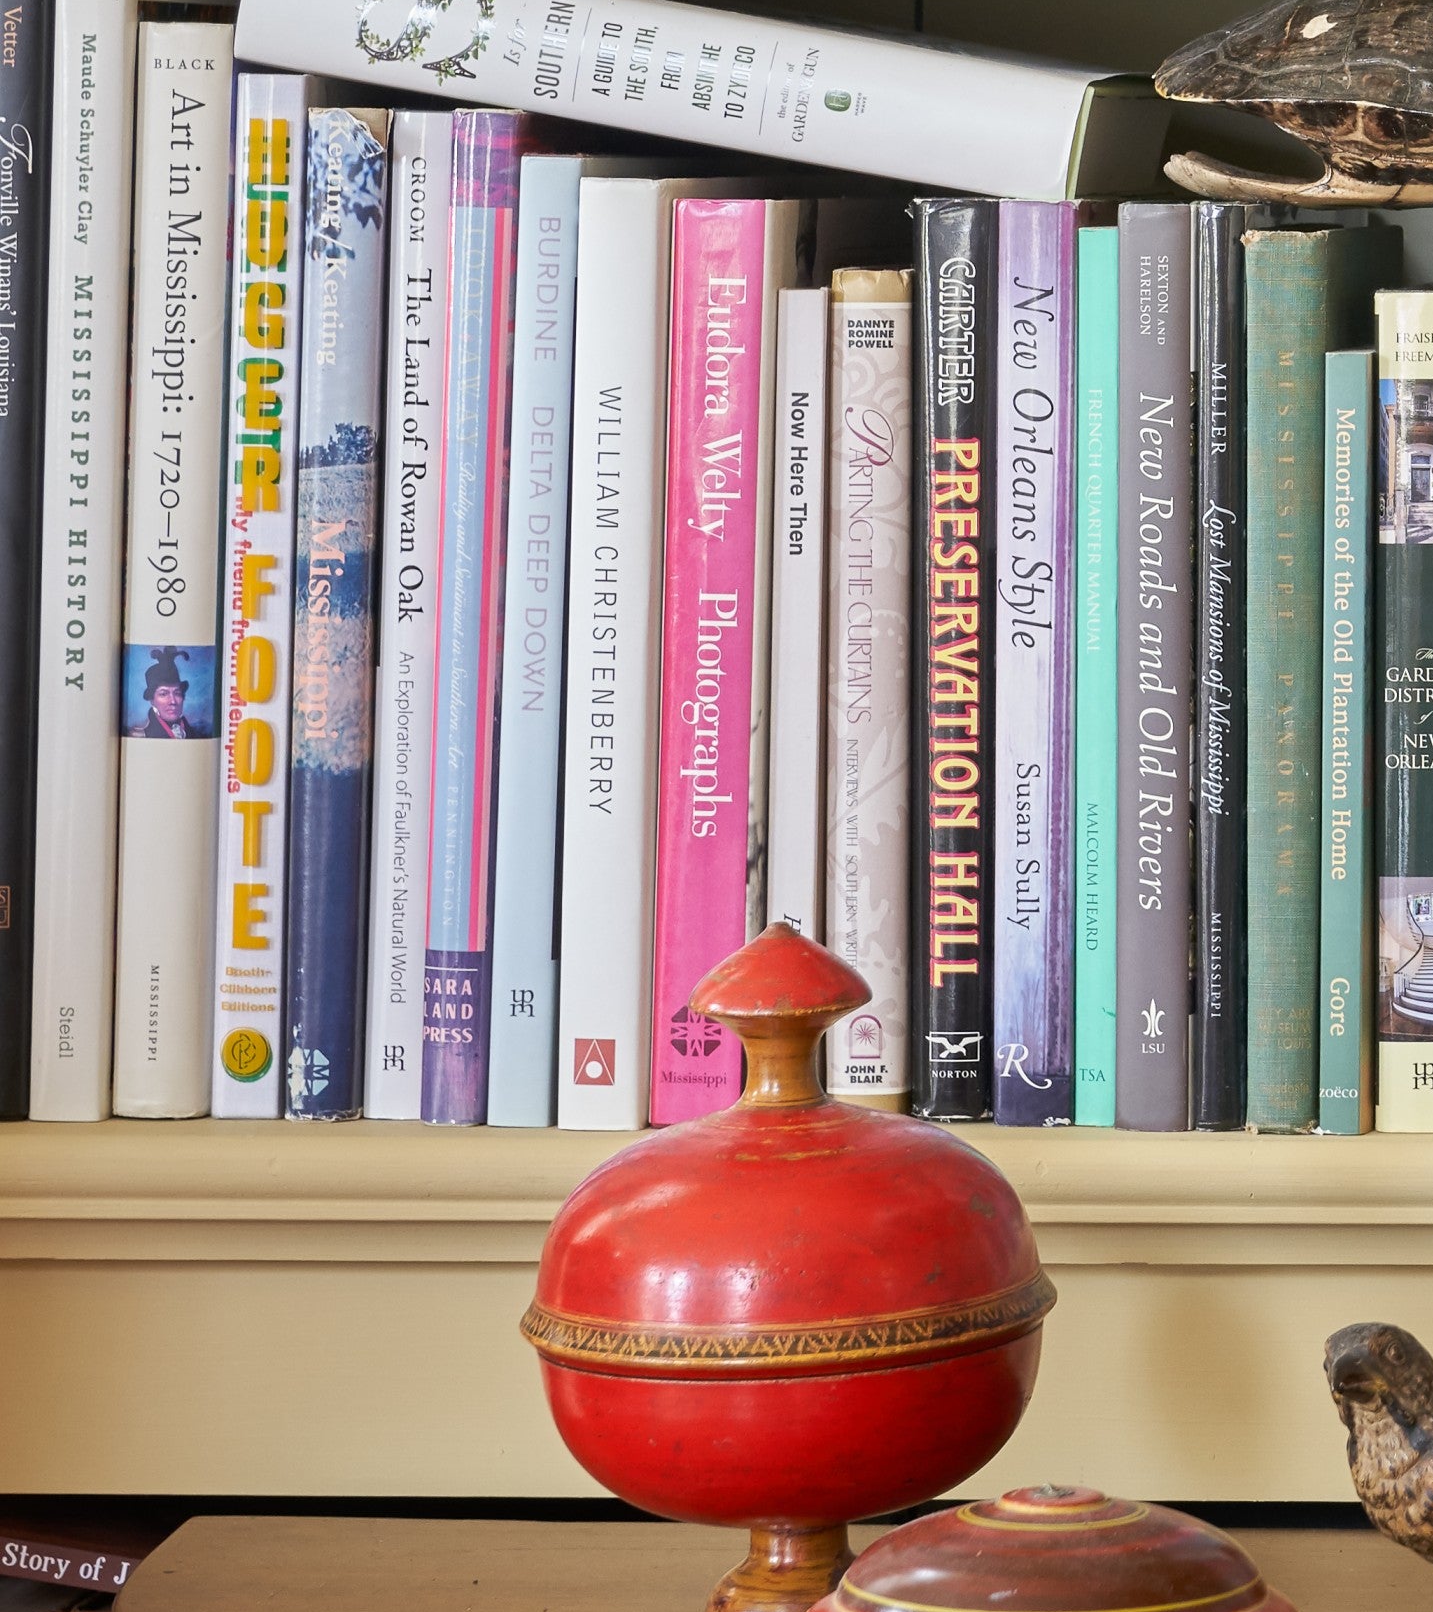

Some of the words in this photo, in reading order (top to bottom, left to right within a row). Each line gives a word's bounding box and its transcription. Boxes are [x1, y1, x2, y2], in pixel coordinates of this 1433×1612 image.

[154, 58, 216, 71] BLACK
[847, 320, 895, 330] DANNYE
[848, 330, 894, 339] ROMINE
[848, 340, 894, 349] POWELL
[680, 586, 741, 838] Photographs
[59, 1007, 74, 1060] Steidl
[1141, 1043, 1165, 1054] LSU
[931, 1070, 977, 1078] NORTON
